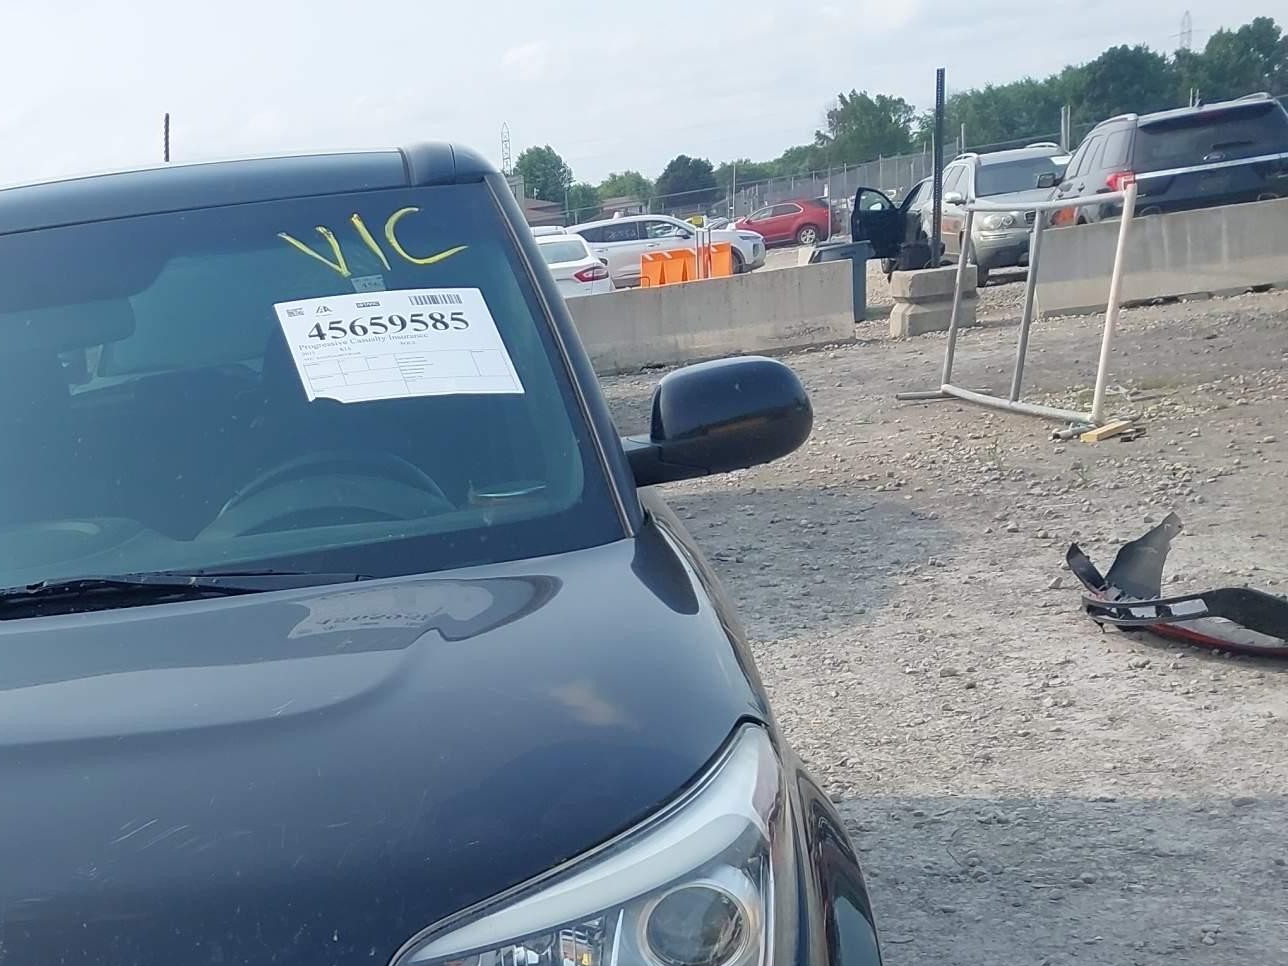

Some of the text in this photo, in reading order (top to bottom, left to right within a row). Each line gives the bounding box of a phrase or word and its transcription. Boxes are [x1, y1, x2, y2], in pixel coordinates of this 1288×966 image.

[277, 206, 470, 278] VIC
[307, 311, 470, 341] 45659585
[298, 332, 429, 351] Progressive Casualty Insurance
